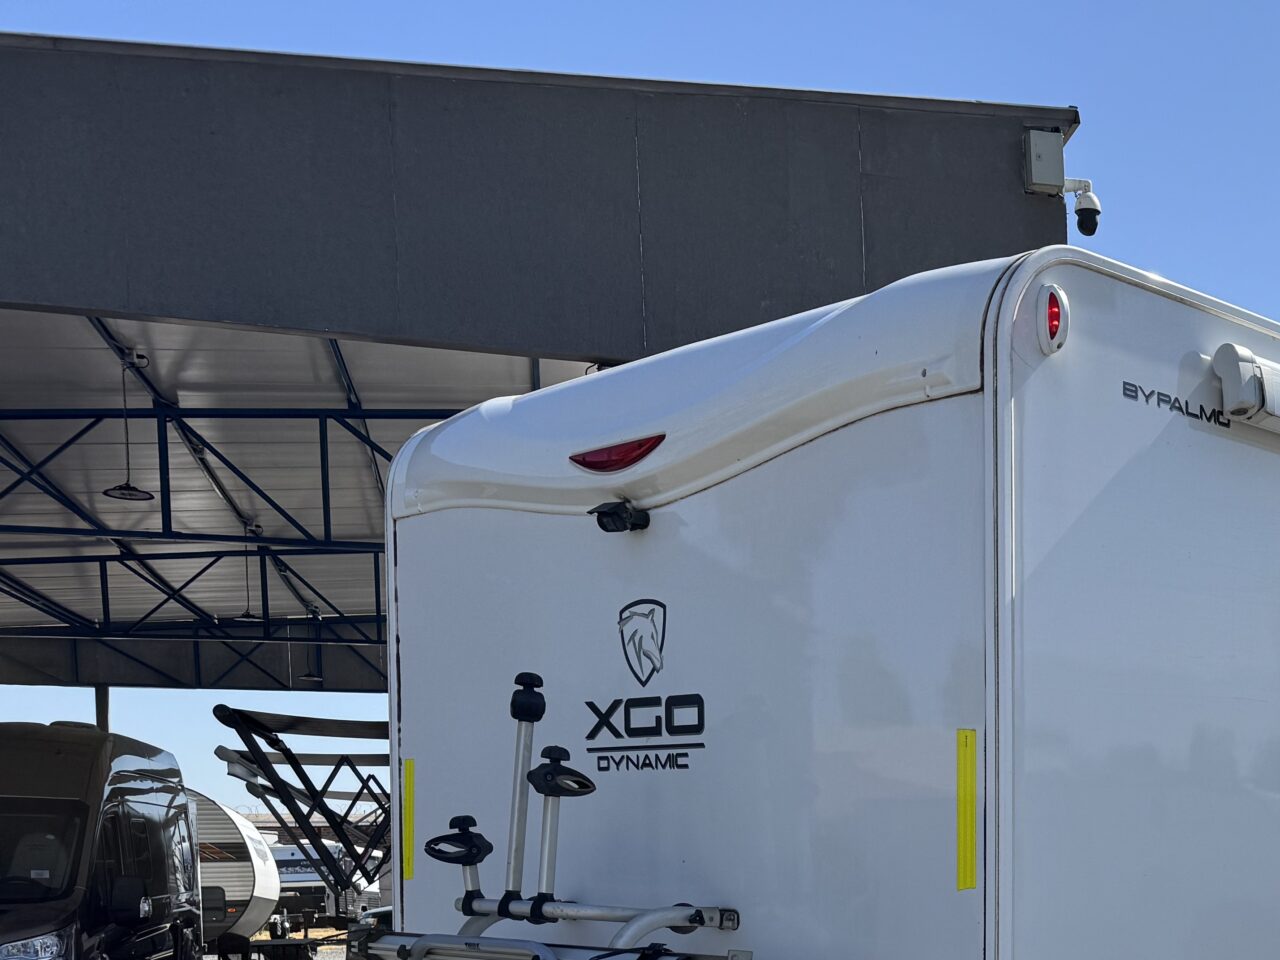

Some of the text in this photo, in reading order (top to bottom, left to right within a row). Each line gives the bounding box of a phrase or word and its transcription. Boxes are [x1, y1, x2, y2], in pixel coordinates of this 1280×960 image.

[1122, 380, 1231, 428] BYPALMO
[583, 693, 705, 741] XGO
[597, 752, 689, 772] DYNAMIC
